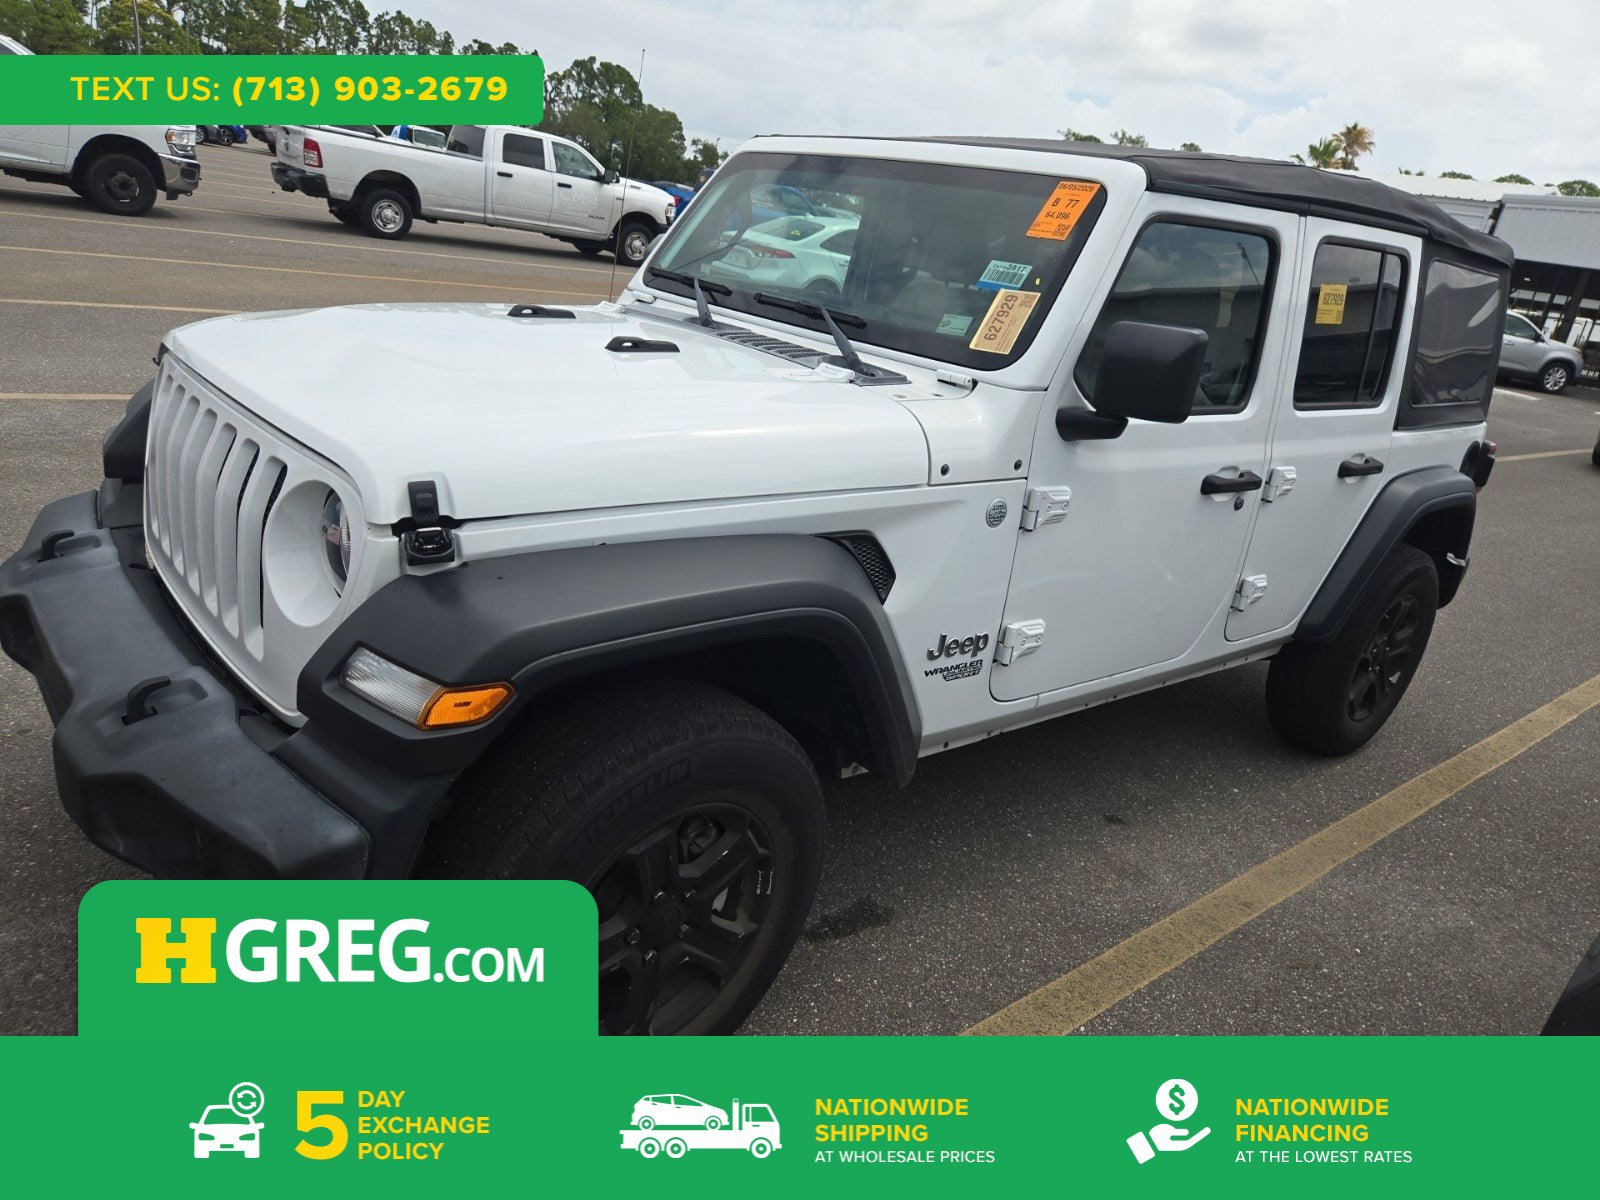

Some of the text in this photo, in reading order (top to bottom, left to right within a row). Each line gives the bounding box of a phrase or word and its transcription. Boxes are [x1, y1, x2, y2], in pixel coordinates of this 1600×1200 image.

[1052, 198, 1080, 208] B 77
[984, 294, 1018, 341] 627929
[926, 632, 989, 661] Jeep
[924, 659, 983, 677] WRANGLER
